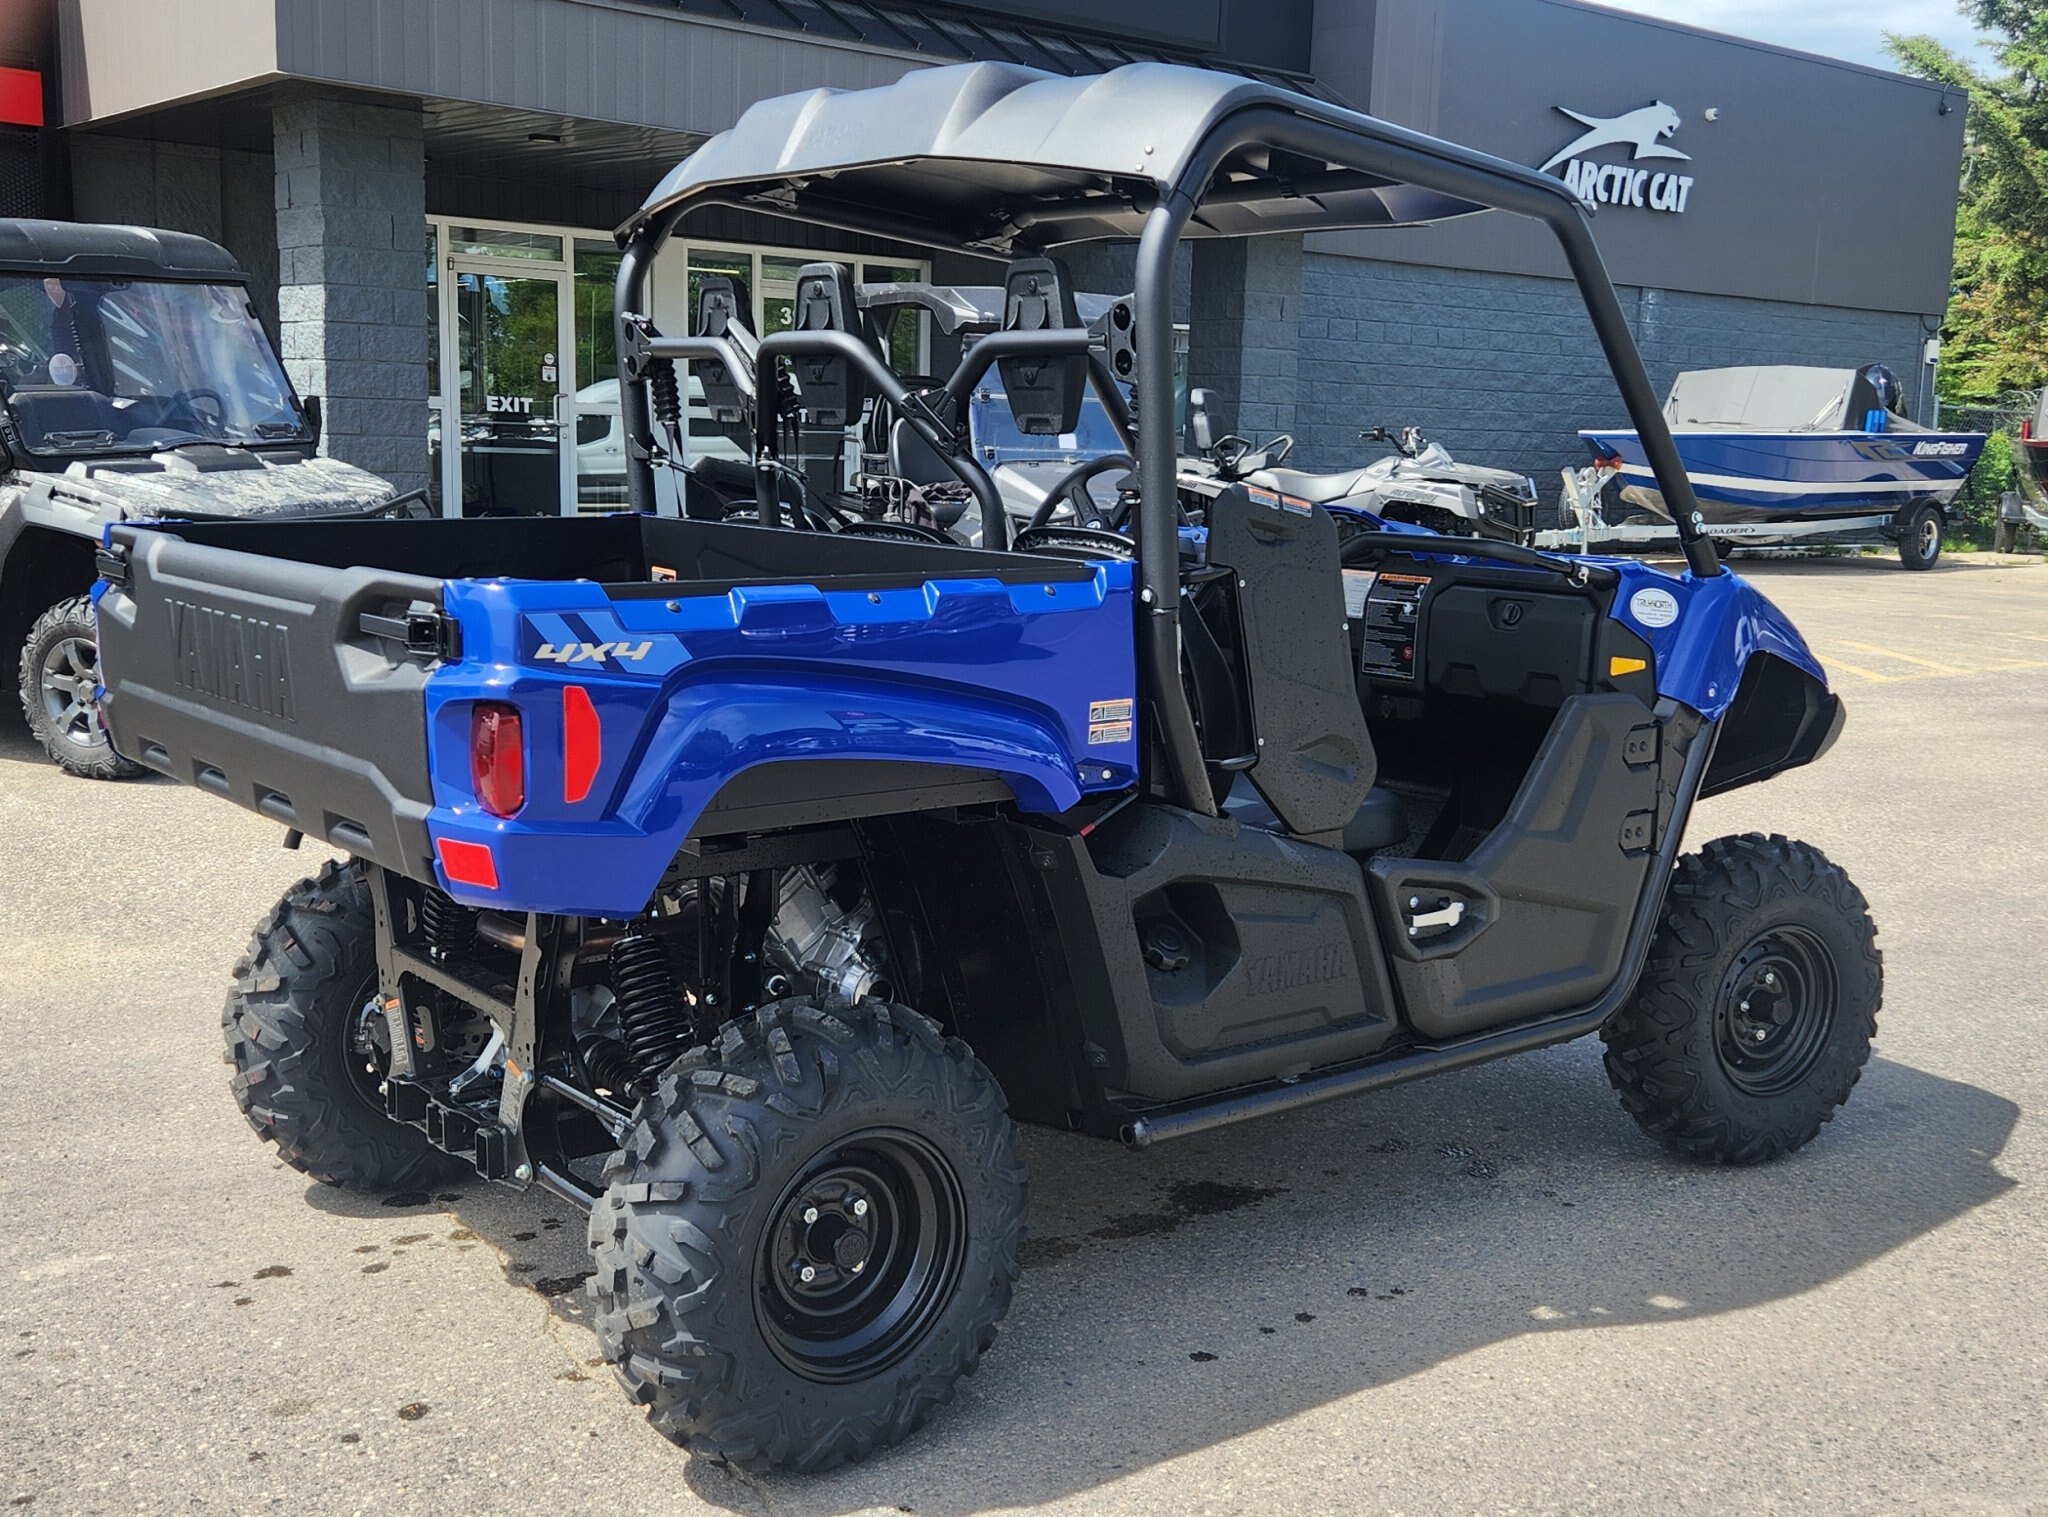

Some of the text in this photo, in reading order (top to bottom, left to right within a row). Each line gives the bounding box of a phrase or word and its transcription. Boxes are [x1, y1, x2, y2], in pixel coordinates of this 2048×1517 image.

[1564, 158, 1694, 213] ARCTIC CAT
[486, 395, 533, 413] EXIT
[1705, 527, 1749, 535] OADER
[164, 598, 297, 722] YAMAHA
